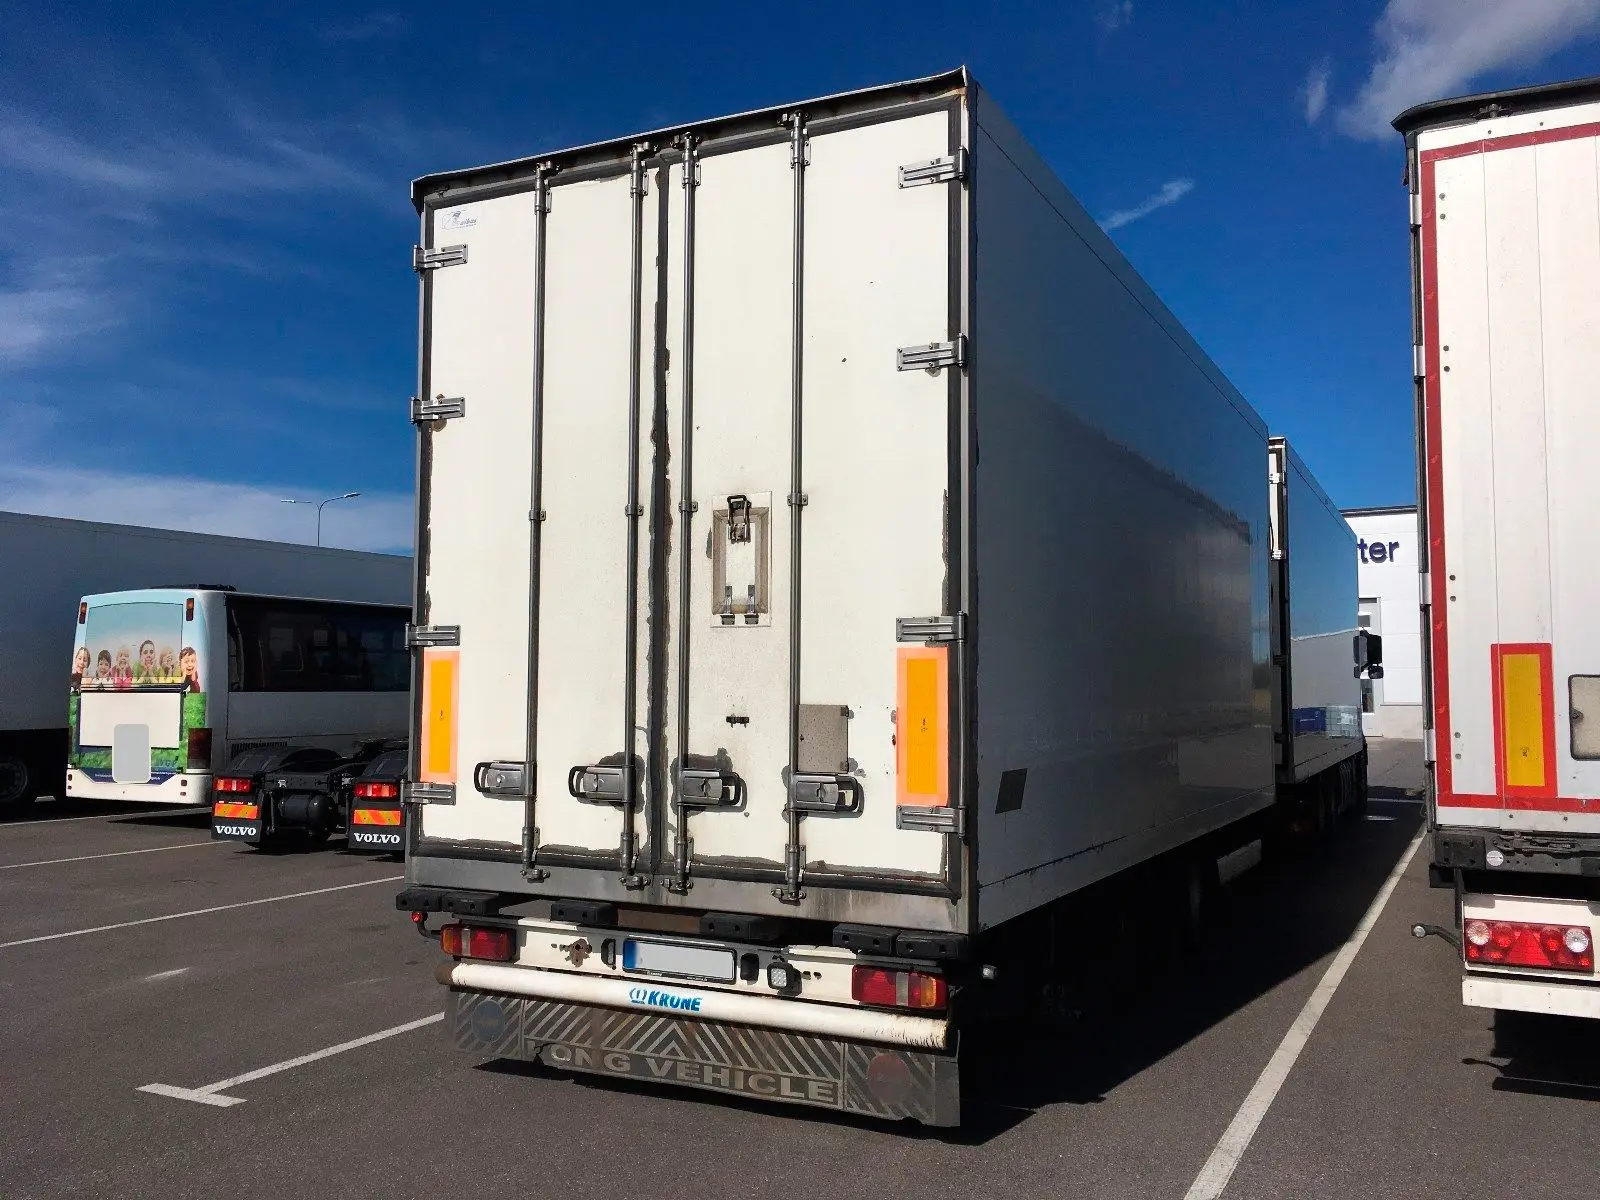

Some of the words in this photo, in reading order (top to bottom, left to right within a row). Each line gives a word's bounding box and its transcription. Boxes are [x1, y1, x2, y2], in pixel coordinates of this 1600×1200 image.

[215, 825, 257, 836] VOLVO
[353, 832, 400, 844] VOLVO
[645, 1057, 834, 1103] VEHICLE
